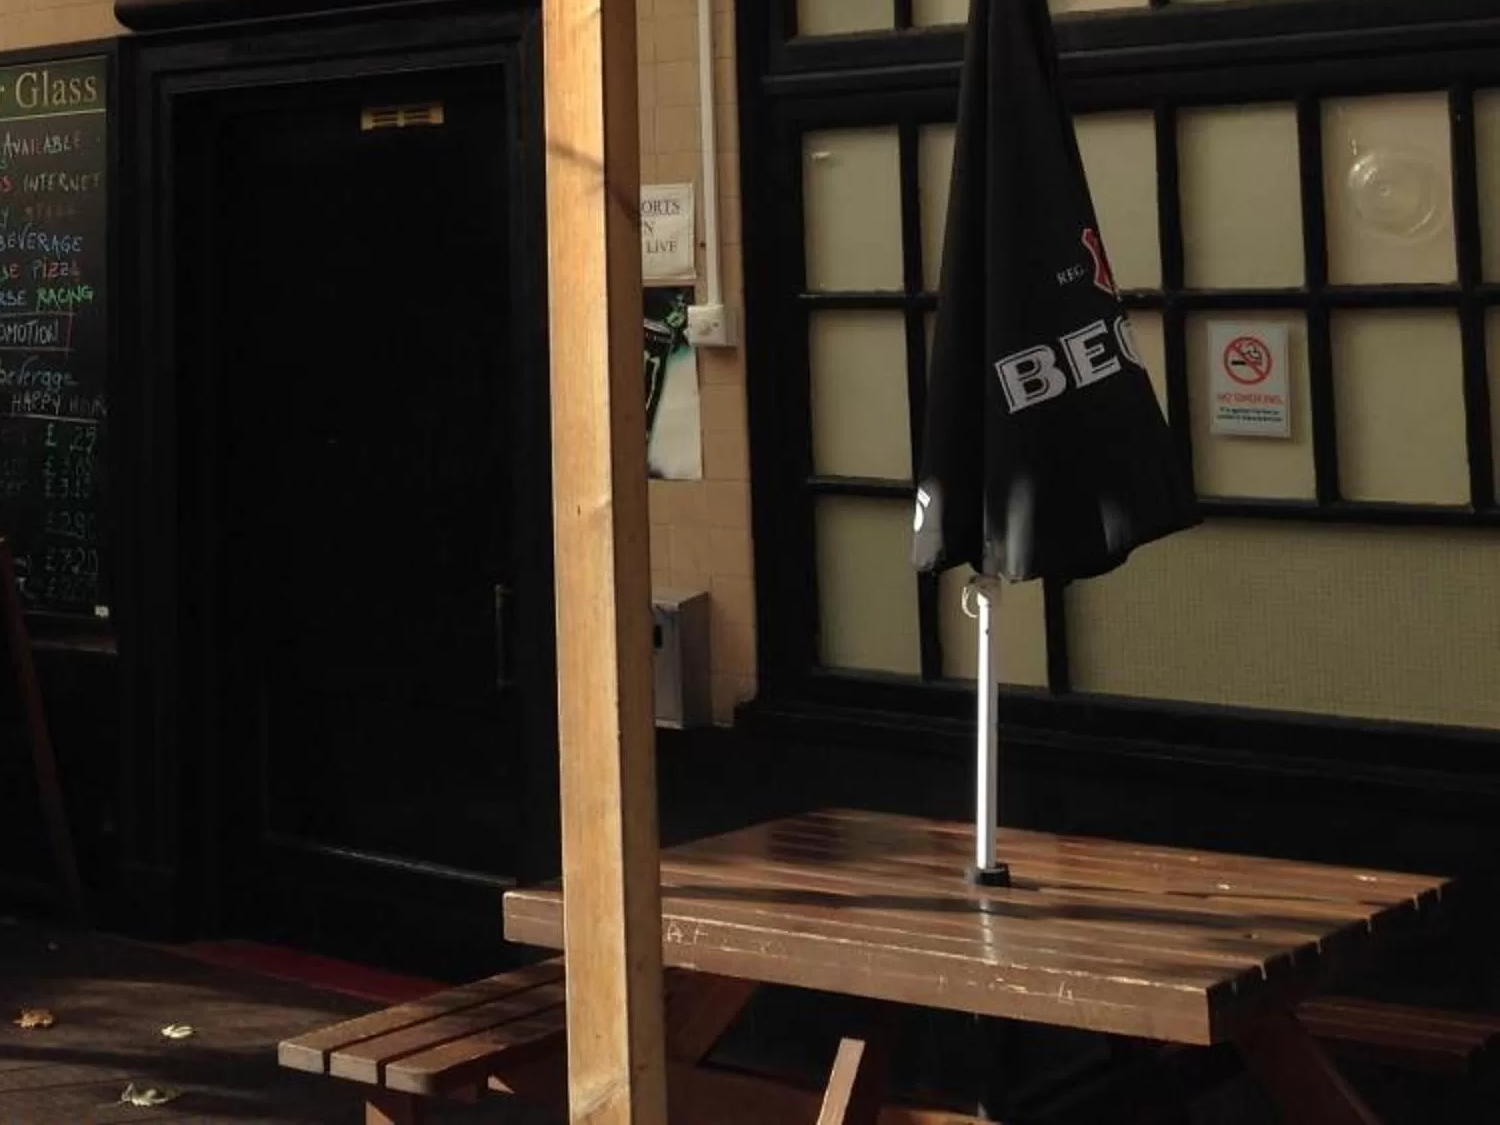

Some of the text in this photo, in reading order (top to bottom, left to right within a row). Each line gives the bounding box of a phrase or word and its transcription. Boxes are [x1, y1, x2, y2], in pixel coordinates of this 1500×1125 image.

[15, 71, 99, 108] Glass
[4, 131, 82, 158] AVAILABLE
[23, 171, 101, 192] INTERNET
[641, 200, 680, 216] ORTS
[646, 239, 677, 254] LIVE
[36, 284, 95, 312] RACING
[11, 390, 61, 415] HAPPY
